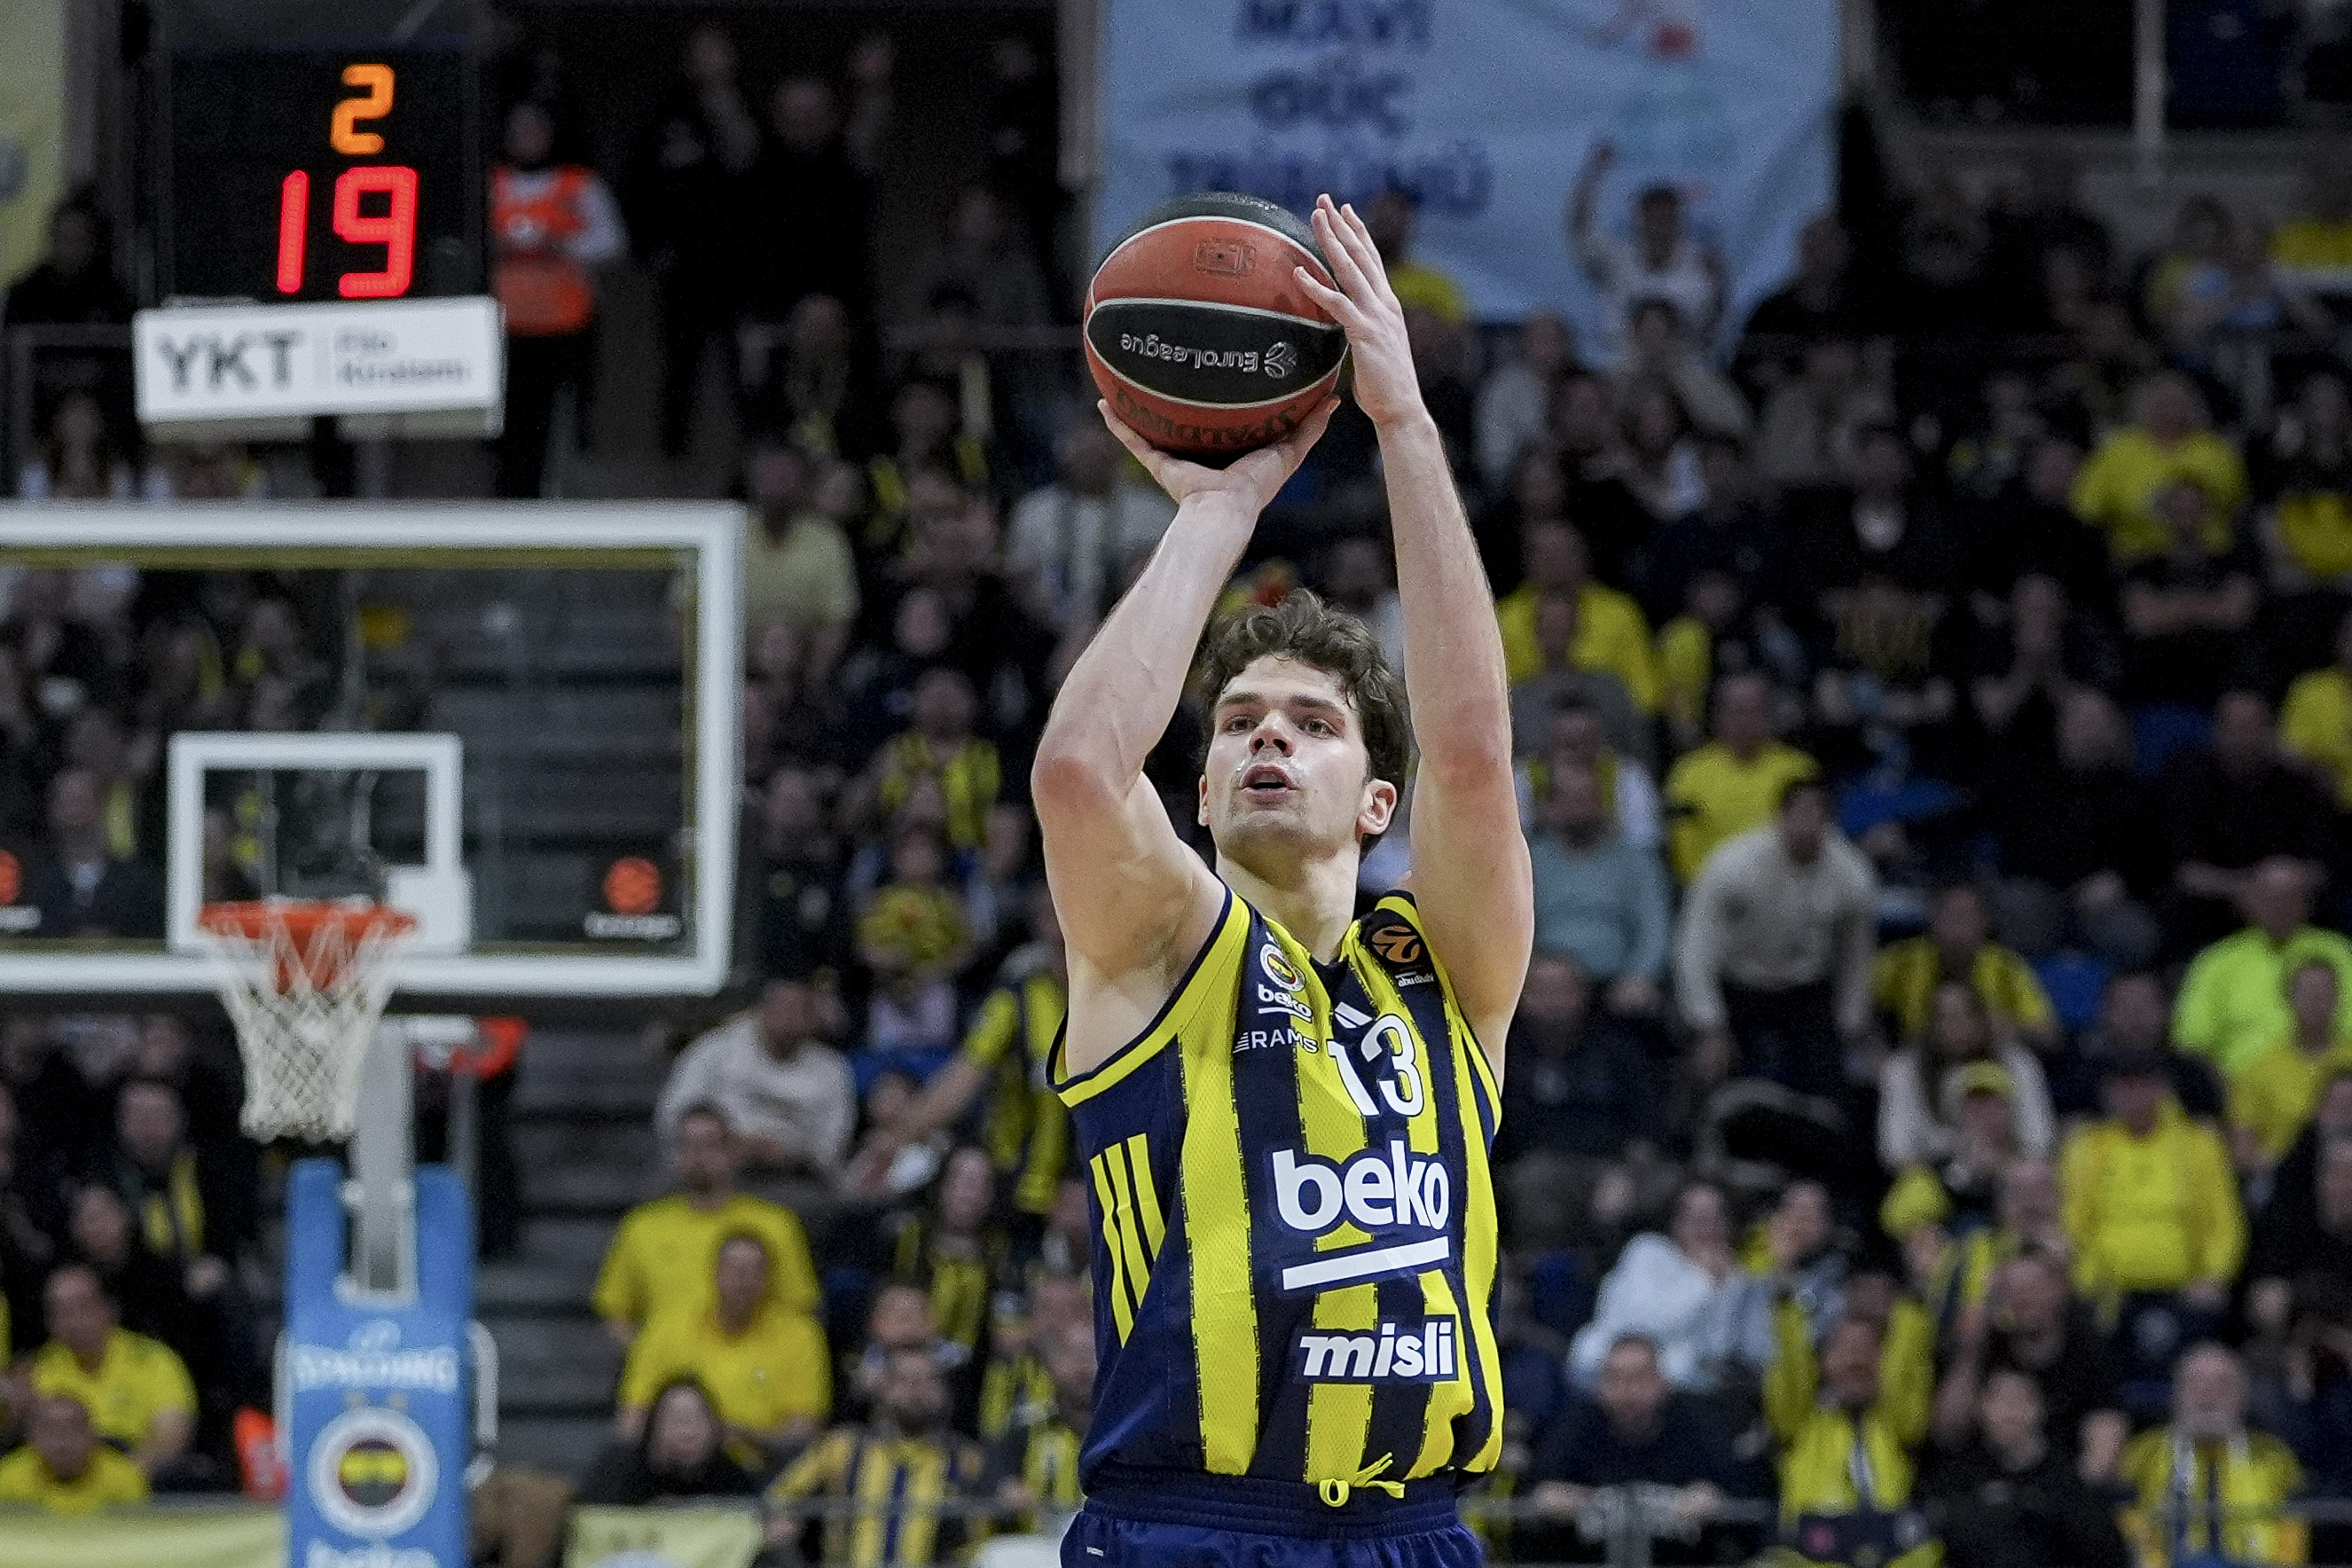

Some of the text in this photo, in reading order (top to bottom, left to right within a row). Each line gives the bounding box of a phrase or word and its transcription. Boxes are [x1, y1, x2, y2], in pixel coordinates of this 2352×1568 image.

[331, 64, 395, 154] 2
[277, 166, 418, 298] 19
[158, 331, 302, 393] YKT
[1120, 333, 1258, 372] EuroLeague
[1258, 983, 1313, 1017] beko
[1251, 1029, 1319, 1054] RAMS
[1327, 1014, 1424, 1117] 13
[1273, 1141, 1450, 1231] beko
[1300, 1321, 1454, 1378] misli
